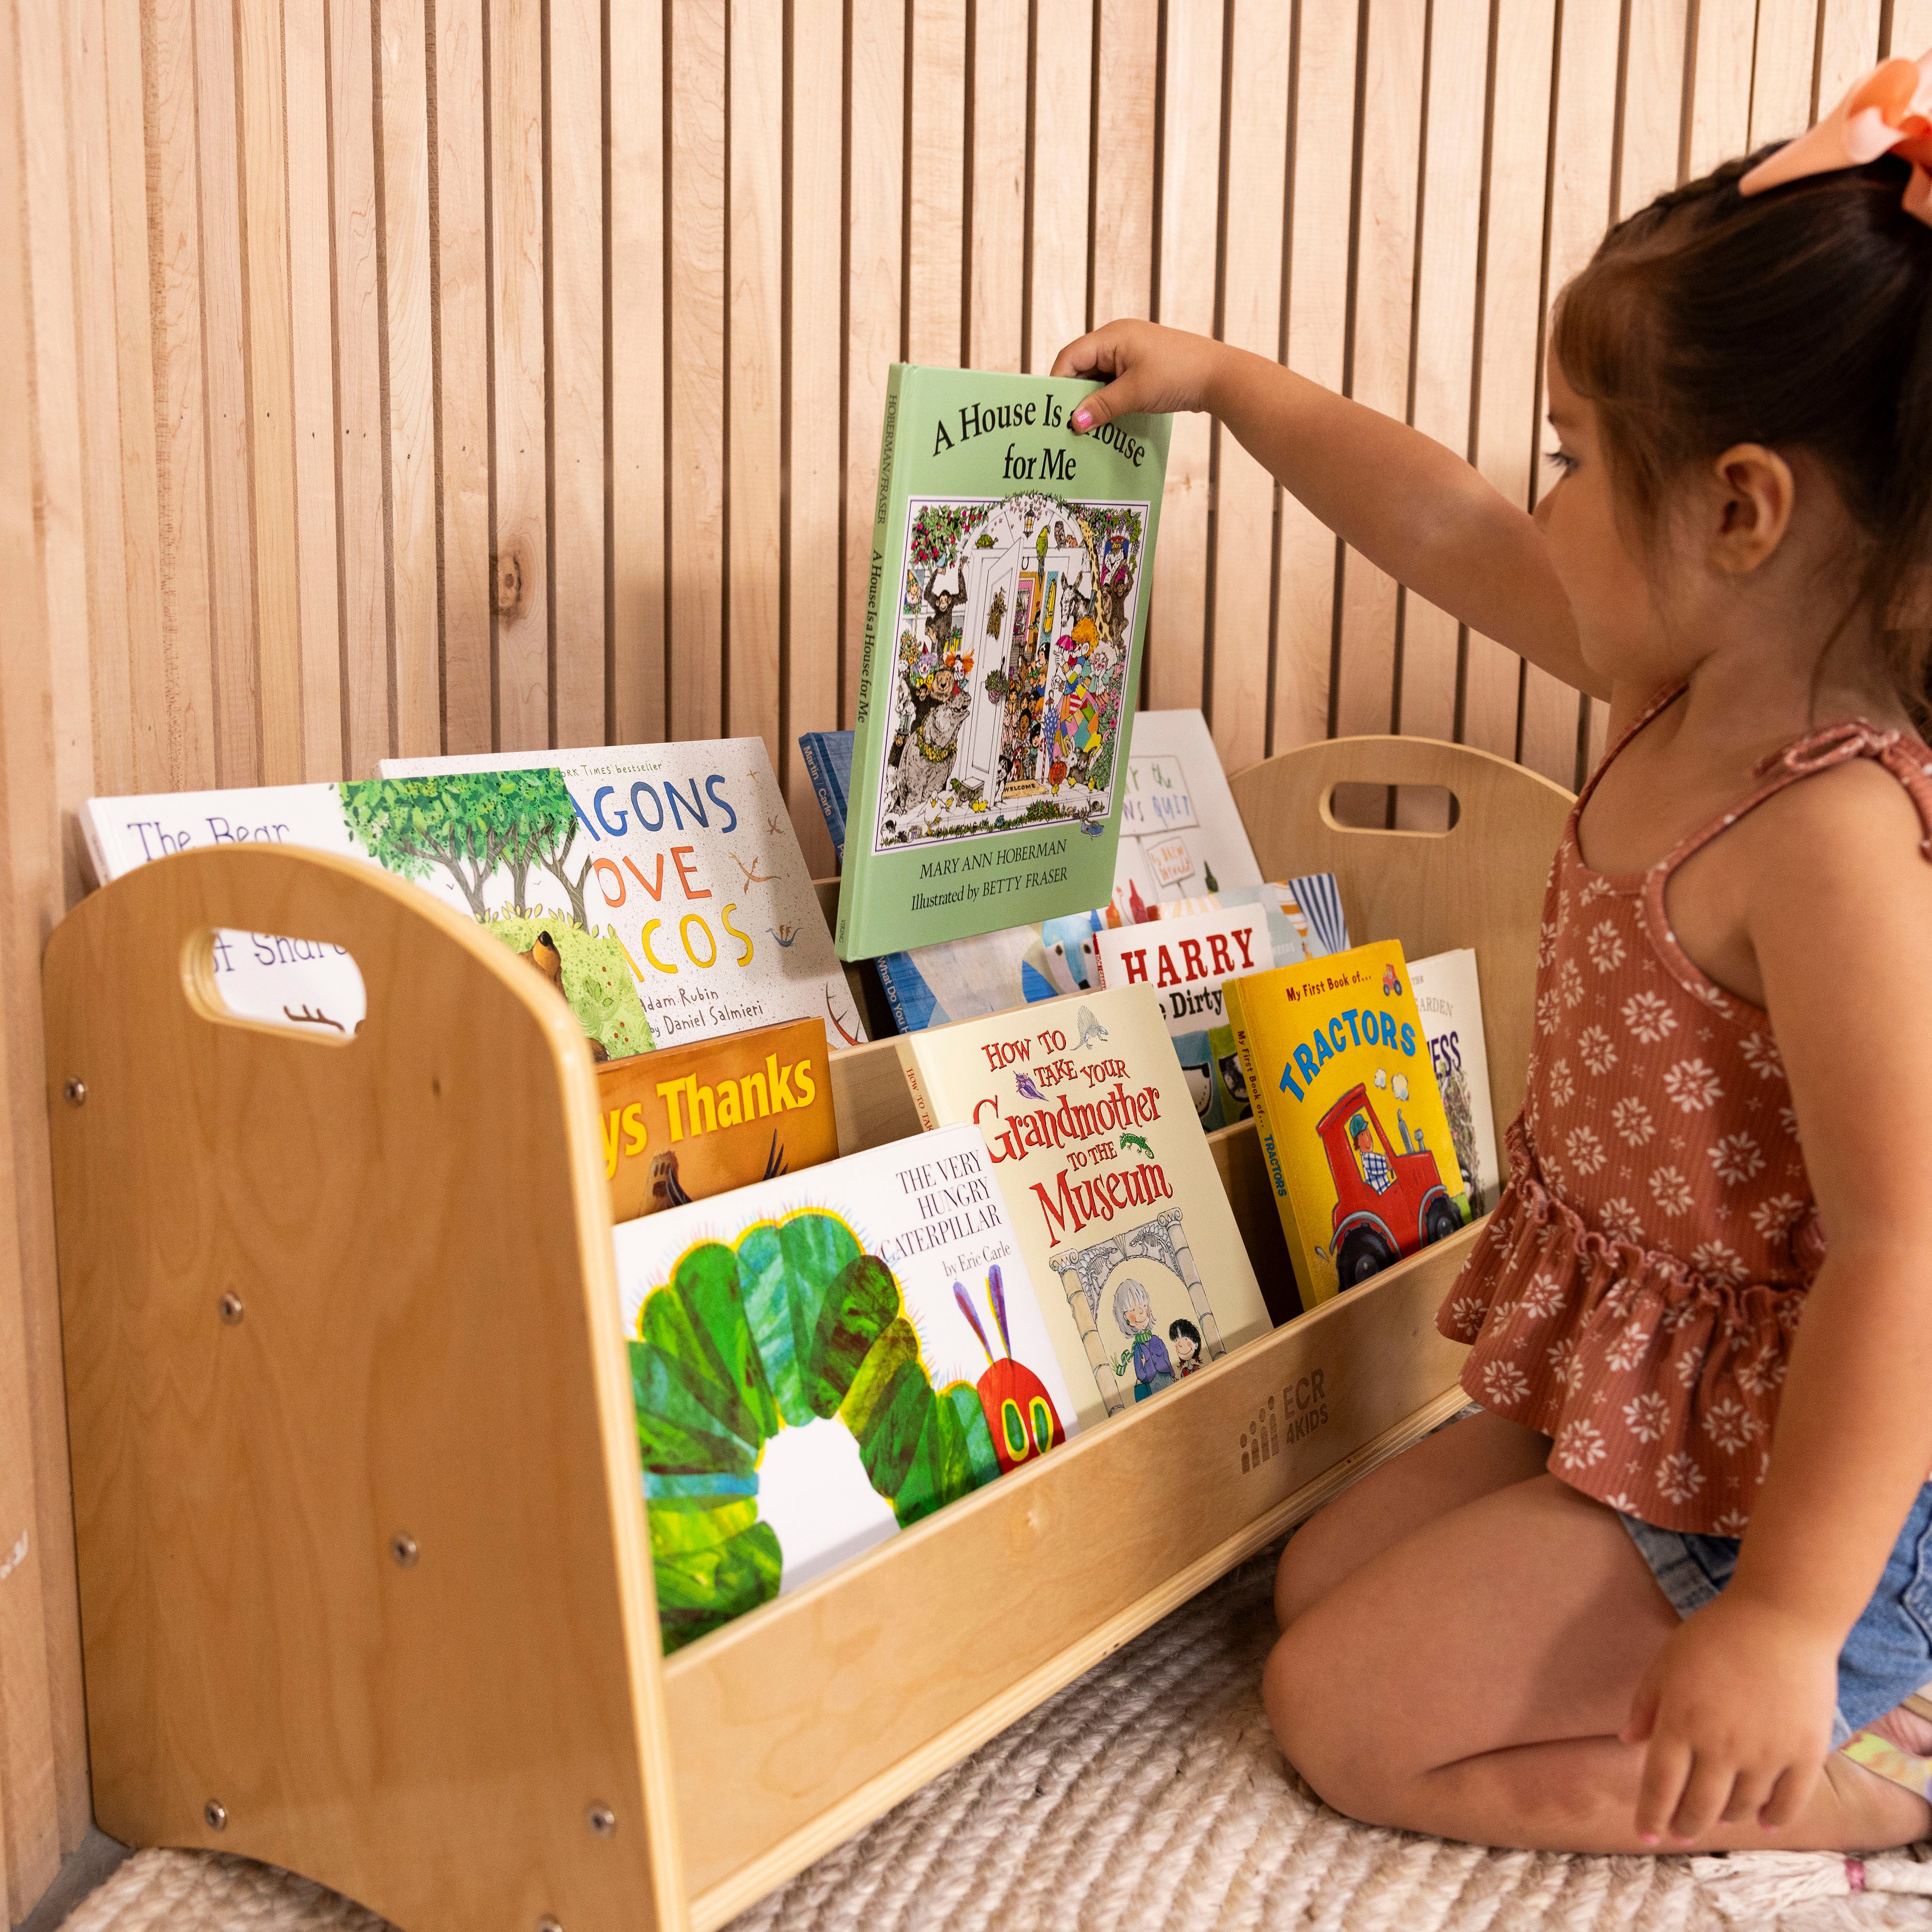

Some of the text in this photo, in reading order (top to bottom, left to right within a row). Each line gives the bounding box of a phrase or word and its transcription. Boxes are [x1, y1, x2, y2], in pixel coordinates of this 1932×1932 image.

[933, 420, 955, 457] A
[959, 402, 1036, 442] House
[1042, 394, 1062, 427] Is
[1085, 422, 1145, 468] ouse
[1002, 443, 1076, 480] for Me
[873, 549, 883, 562] A
[868, 564, 882, 609] House
[867, 611, 877, 622] Is
[862, 634, 875, 676] House
[860, 678, 871, 699] for
[858, 699, 869, 723] Me
[615, 763, 662, 773] bestseller
[803, 745, 820, 781] Martin
[818, 788, 832, 816] Carle
[1004, 783, 1036, 792] WELCOME
[127, 822, 191, 861] The
[206, 817, 290, 844] Bear
[920, 839, 1067, 879] MARY ANN HOBERMAN
[911, 867, 1067, 910] Illustrated by BETTY FRASER
[1121, 927, 1254, 988] HARRY
[679, 987, 719, 1007] Rubin
[877, 956, 893, 985] What
[887, 986, 897, 1002] Do
[894, 1002, 905, 1025] You
[1169, 986, 1222, 1019] Dirty
[1286, 987, 1300, 1001] My
[1303, 982, 1325, 997] First
[1327, 974, 1349, 990] Book
[663, 1010, 706, 1035] Daniel
[710, 1000, 764, 1025] Salmieri
[981, 1030, 1066, 1072] HOW TO
[1279, 1009, 1416, 1103] TRACTORS
[906, 1067, 920, 1092] HOW
[916, 1094, 925, 1109] TO
[1034, 1059, 1131, 1088] TAKE YOUR
[656, 1052, 815, 1143] Thanks
[1237, 1030, 1245, 1045] My
[1242, 1049, 1253, 1072] First
[1249, 1075, 1261, 1100] Book
[1264, 1134, 1287, 1197] TRACTORS
[973, 1083, 1162, 1164] Grandmother
[896, 1150, 982, 1194] THE VERY
[1066, 1141, 1118, 1171] TO THE
[916, 1176, 991, 1220] HUNGRY
[1029, 1164, 1173, 1248] Museum
[881, 1204, 1003, 1262] CATERPILLAR
[942, 1241, 1011, 1280] by Eric Carle
[1283, 1368, 1325, 1421] ECR
[1286, 1403, 1328, 1445] 4KIDS
